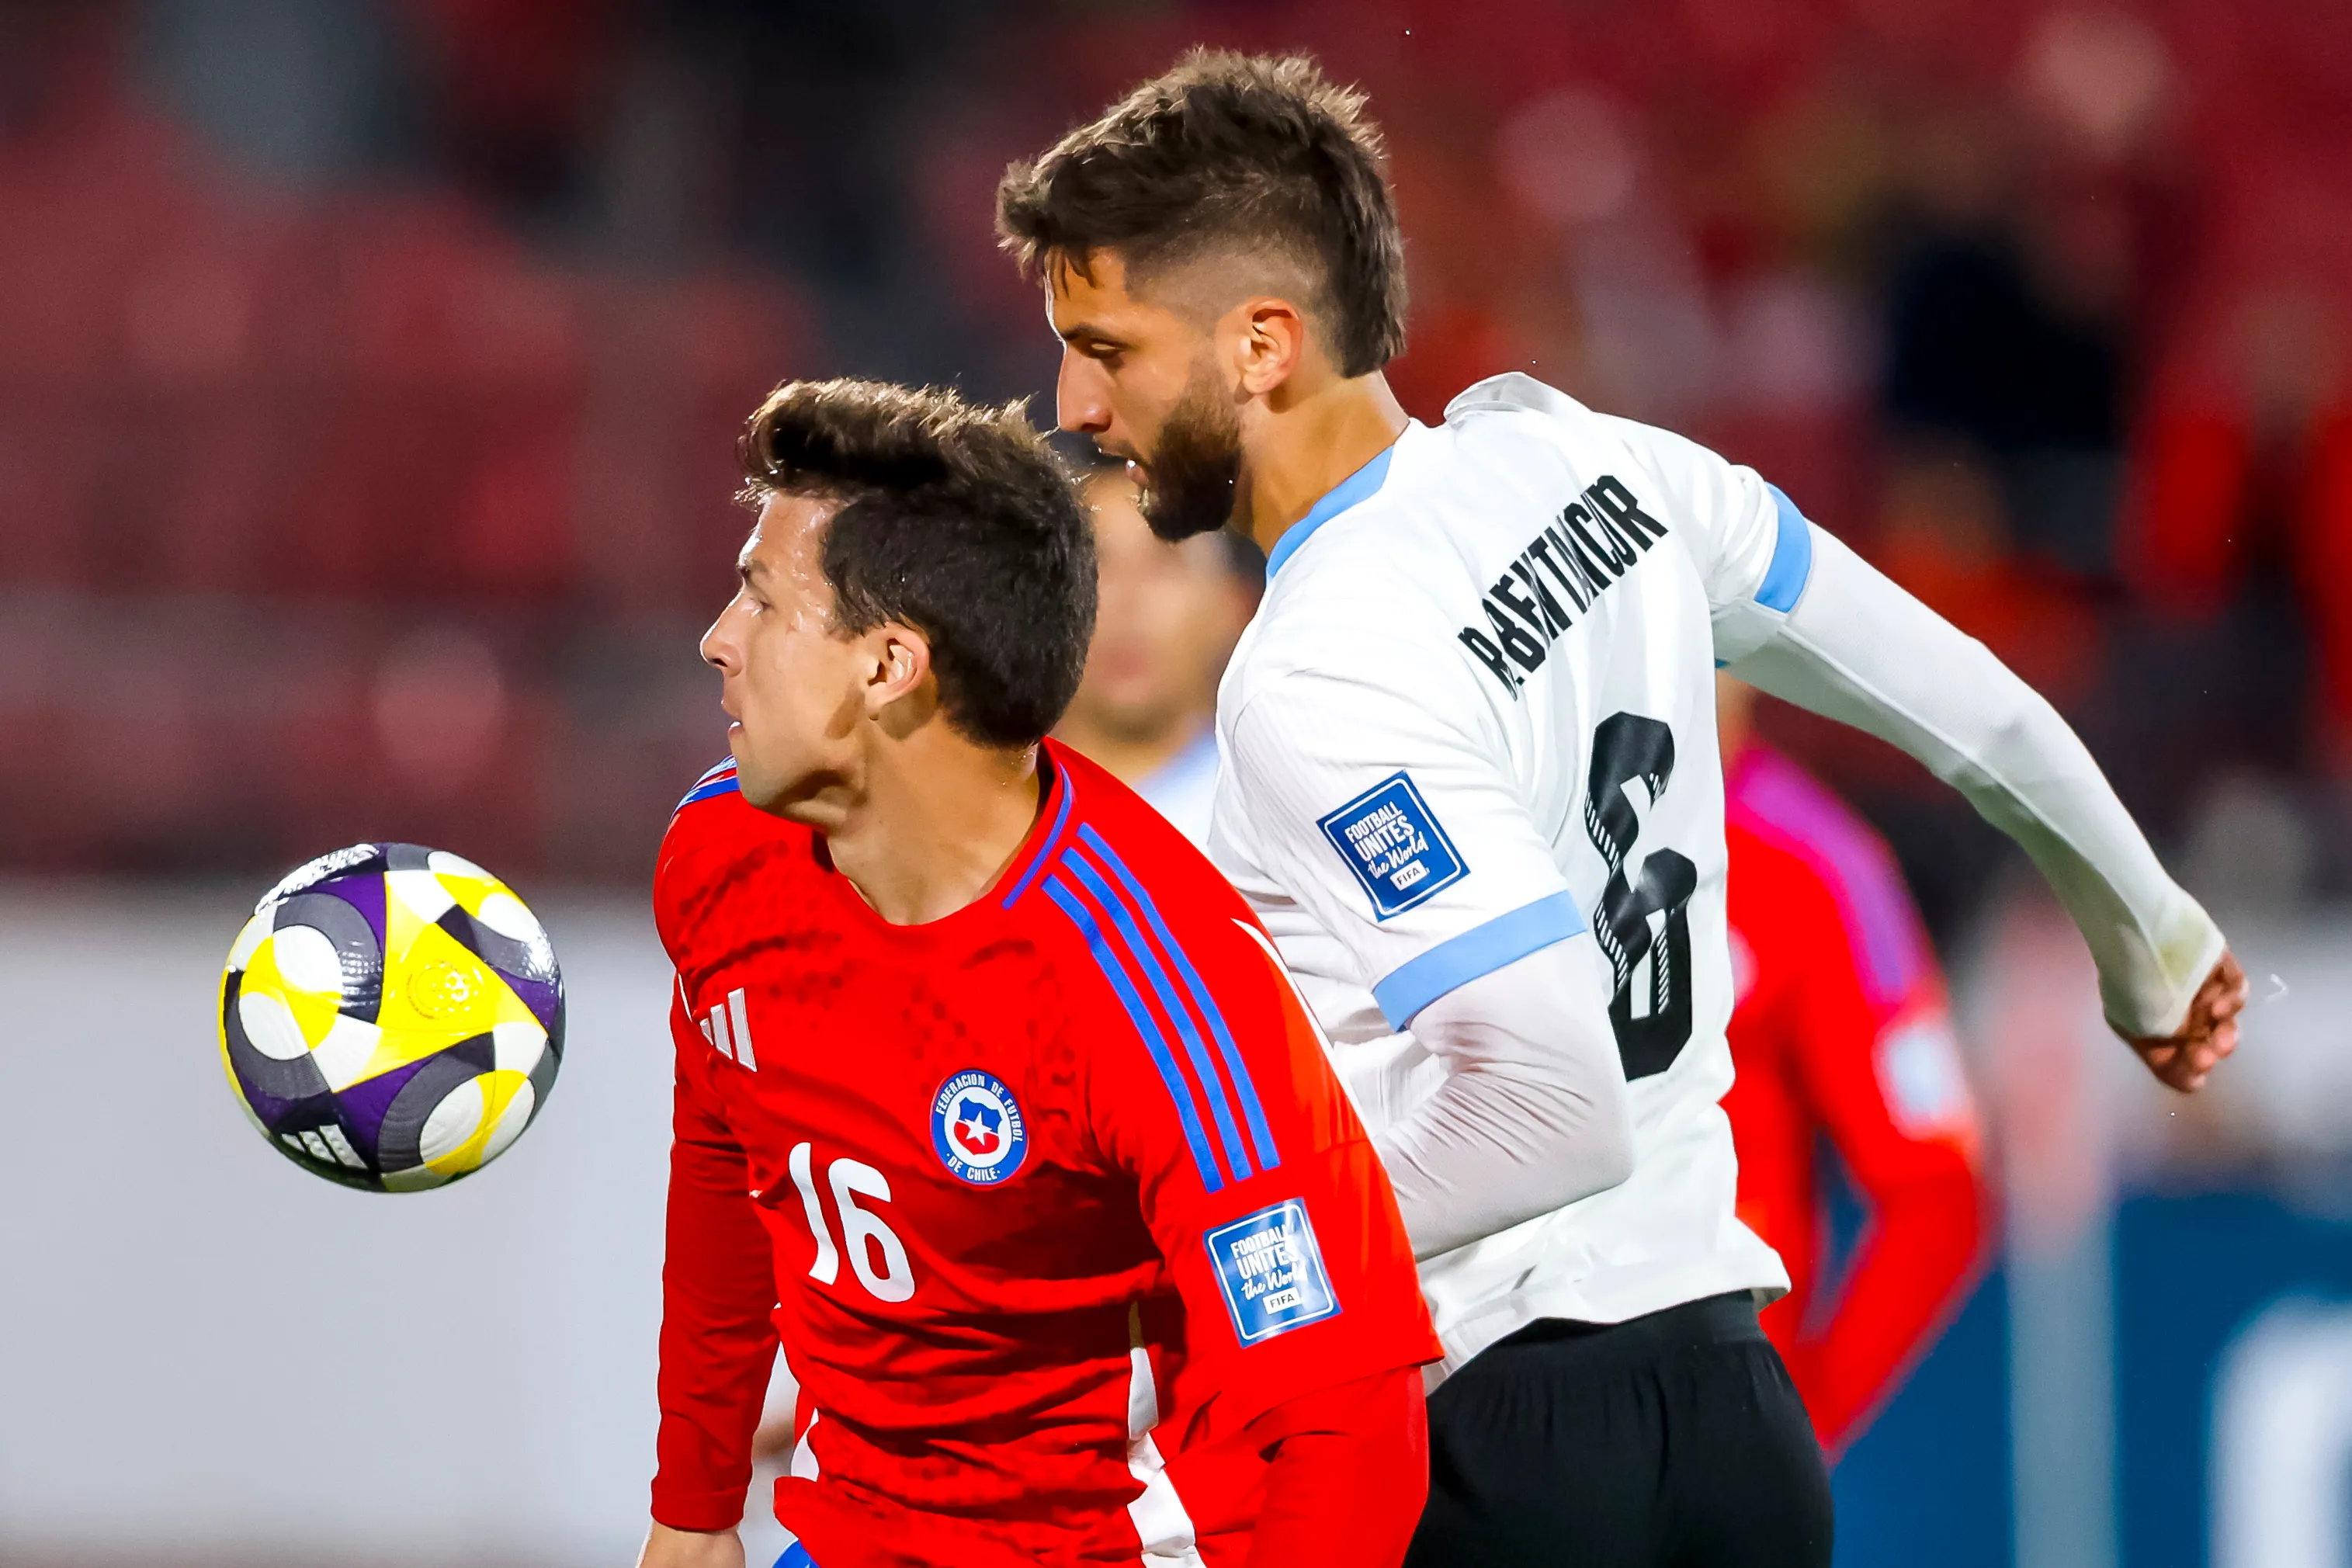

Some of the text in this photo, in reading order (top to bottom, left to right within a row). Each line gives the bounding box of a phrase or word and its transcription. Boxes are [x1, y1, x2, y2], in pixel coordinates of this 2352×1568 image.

[1344, 801, 1403, 843] FOOTBALL
[1354, 814, 1415, 862] UNITES
[1367, 831, 1429, 879] the World
[1396, 866, 1421, 886] FIFA
[1584, 711, 1697, 1083] 6
[935, 1074, 1023, 1142] FEDERACION DE FUTBOL
[966, 1167, 997, 1181] CHILE
[789, 1142, 915, 1303] 16
[1237, 1241, 1299, 1279] UNITES
[1241, 1278, 1266, 1300] the
[1269, 1293, 1296, 1308] FIFA
